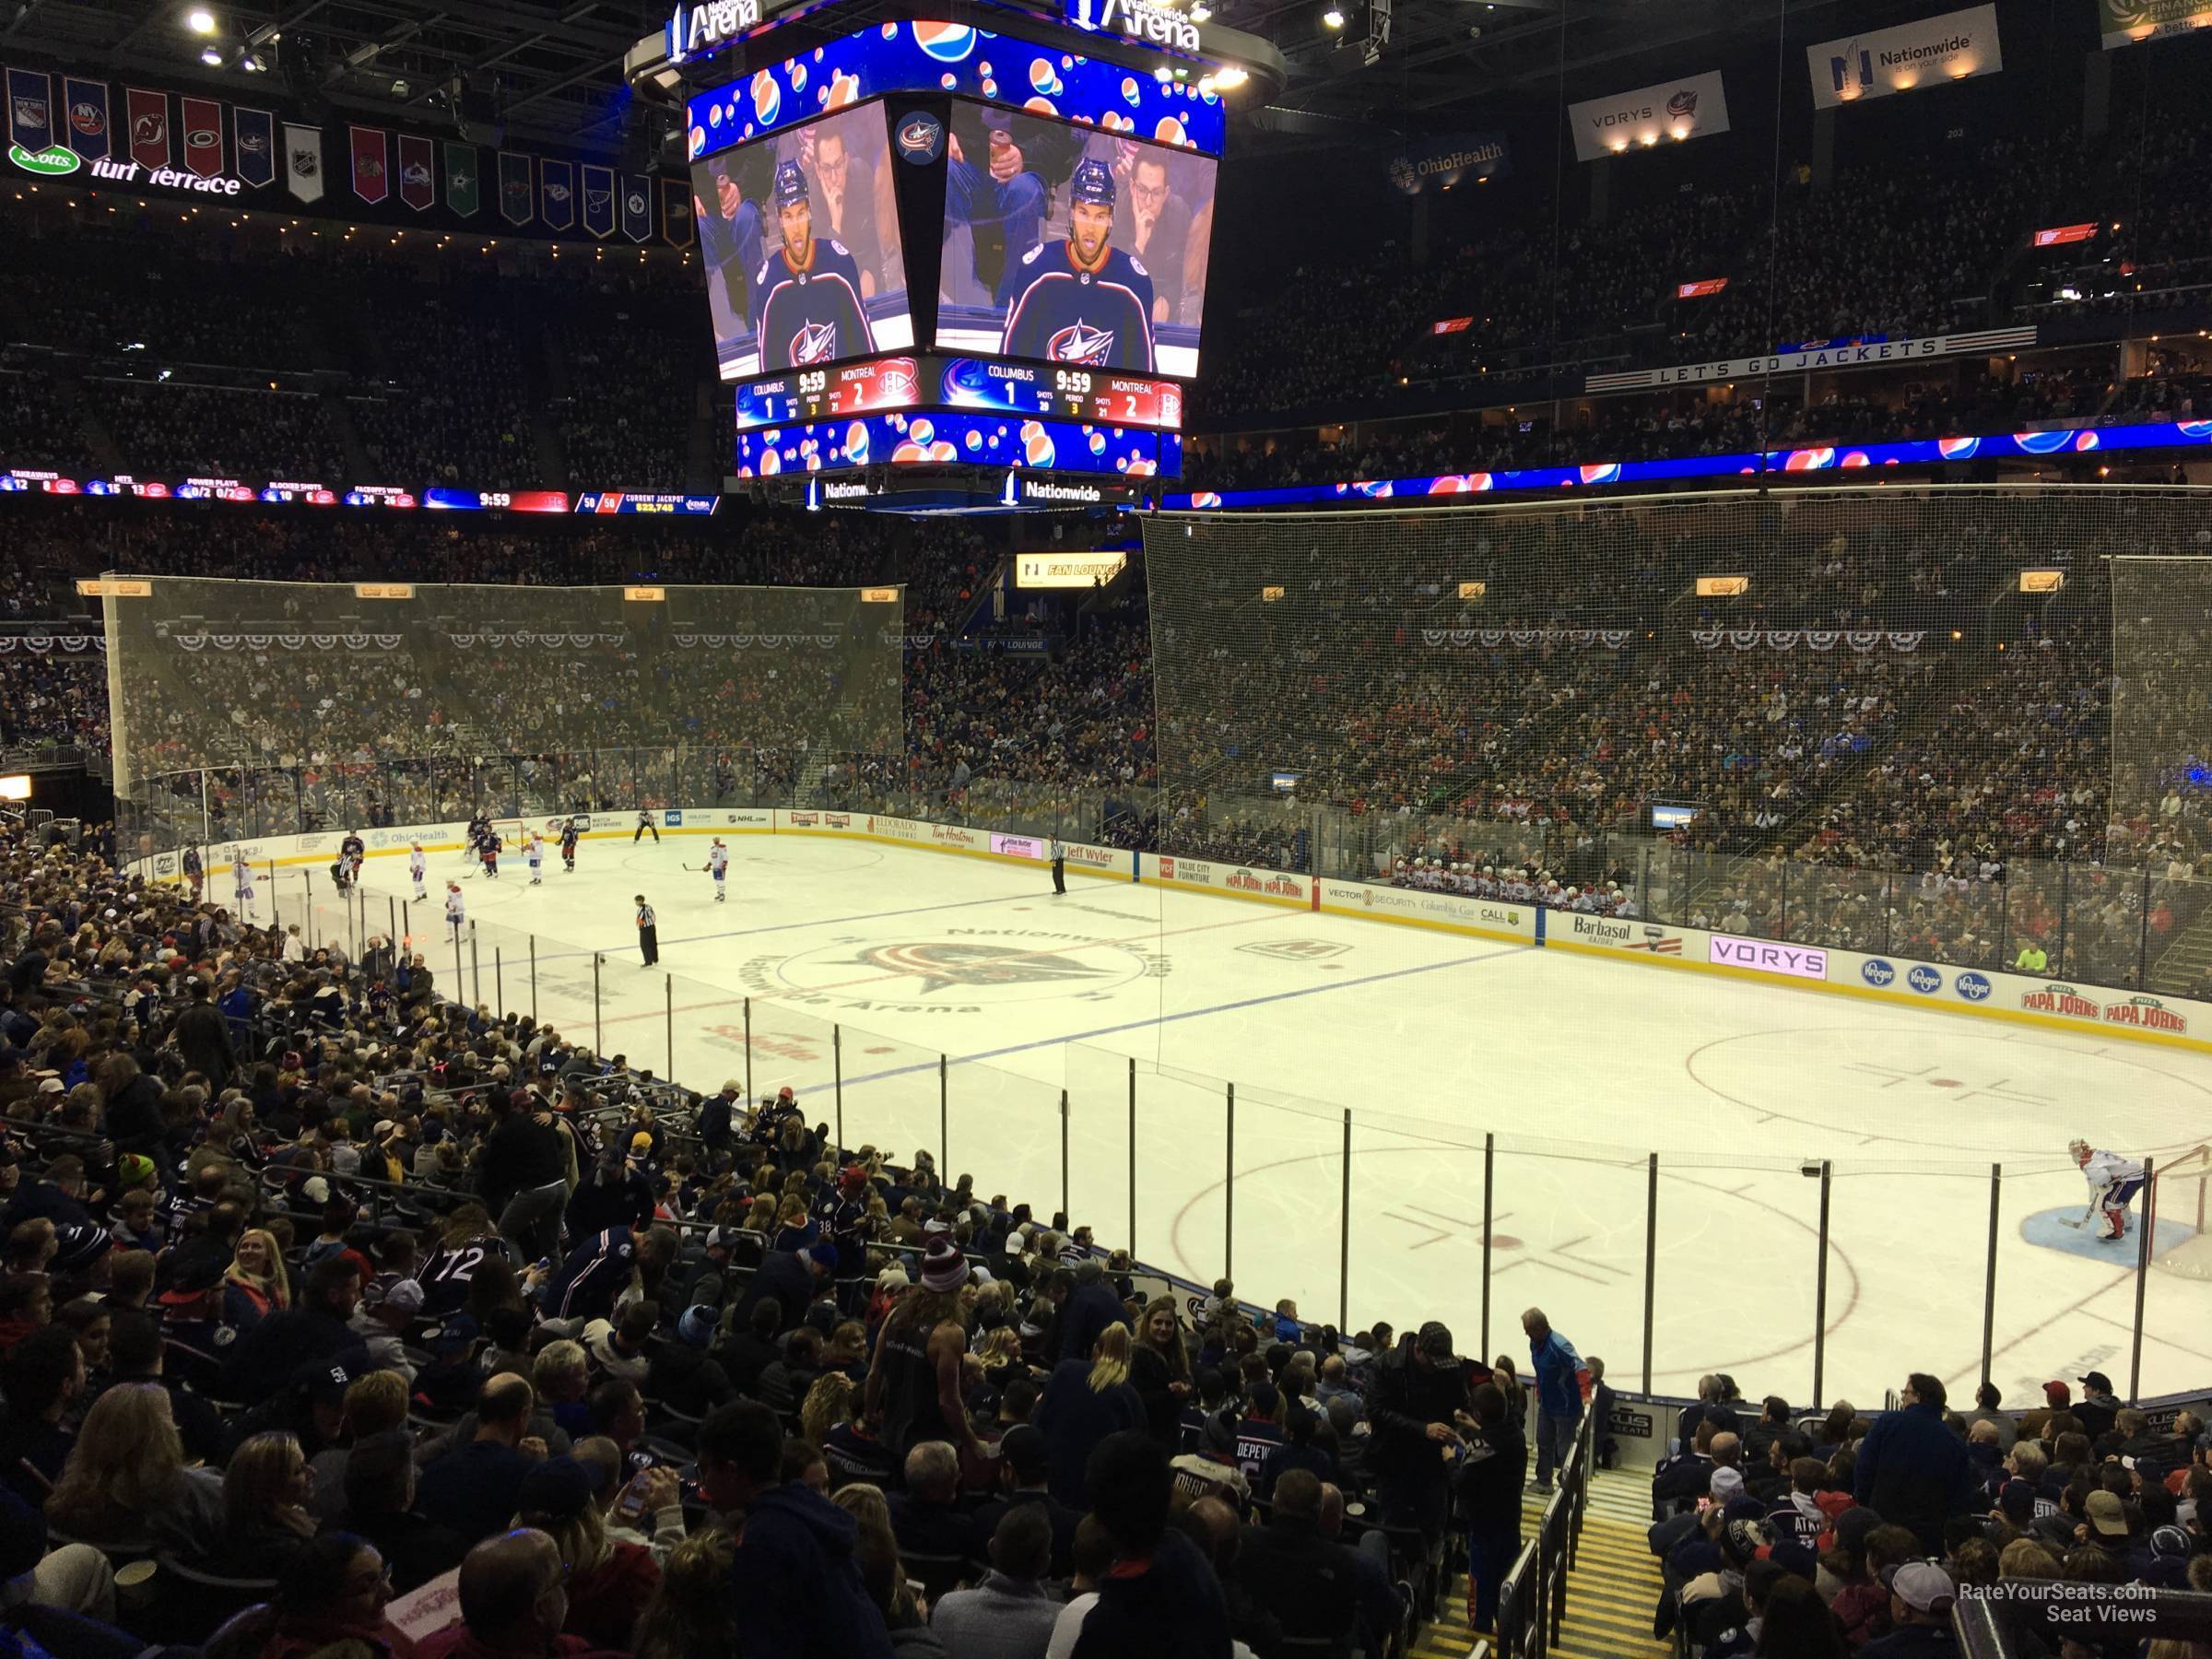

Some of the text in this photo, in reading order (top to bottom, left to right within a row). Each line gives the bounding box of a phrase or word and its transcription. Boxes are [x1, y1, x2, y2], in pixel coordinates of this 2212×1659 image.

[688, 0, 758, 49] Arena
[1100, 0, 1200, 51] Arena
[1879, 35, 1972, 66] Nationwide
[1904, 61, 1917, 71] on
[1918, 55, 1938, 69] your
[1941, 52, 1959, 64] side
[1593, 107, 1653, 128] VORYS
[18, 149, 72, 168] Scotts
[1418, 142, 1503, 175] OhioHealth
[1660, 339, 1936, 383] LET'S GO JACKETS
[753, 367, 877, 396] COLUMBUS 9:59 MONTREAL
[988, 365, 1153, 394] COLUMBUS 9:59 MONTREAL
[765, 382, 864, 418] 1 2
[1005, 382, 1136, 418] 1 2
[1036, 391, 1111, 406] SHOTS PERIOD SHOTS
[811, 404, 817, 415] 3
[1072, 403, 1078, 414] 3
[11, 470, 58, 479] TAKEAWAYS
[14, 479, 51, 491] 12 8
[107, 483, 145, 495] 15 13
[187, 477, 239, 488] POWER PLAYS
[269, 482, 323, 491] BLOCKED SHOTS
[191, 487, 235, 499] 0/2 0/2
[279, 490, 312, 501] 10 6
[626, 494, 684, 502] CURRENT JACKPOT
[1026, 481, 1100, 501] Nationwide
[363, 494, 396, 505] 24 26
[479, 493, 510, 507] 9:59
[583, 498, 615, 508] 50 50
[636, 503, 674, 512] $22,745
[1048, 564, 1072, 575] FAN
[1006, 641, 1043, 649] LOUNGE
[666, 814, 680, 822] IGS
[877, 818, 916, 830] ELDORADO
[931, 824, 974, 844] Tim Hortons
[1067, 845, 1083, 859] Jeff
[1084, 848, 1113, 864] Wyler
[1159, 862, 1173, 874] VCF
[1178, 861, 1210, 873] VALUE CITY
[1178, 871, 1210, 883] FURNITURE
[1226, 875, 1241, 887] PAPA
[1265, 880, 1281, 894] PAPA
[1328, 888, 1417, 908] VECTOR SECURITY
[1480, 909, 1505, 920] CALL
[1574, 916, 1631, 940] Barbasol
[1588, 935, 1614, 946] RAZORS
[1714, 940, 1823, 973] VORYS
[1864, 962, 1893, 985] Kroger
[1910, 969, 1940, 994] Kroger
[1958, 976, 1991, 1001] Kroger
[836, 1001, 982, 1013] Arena
[2024, 993, 2055, 1012] PAPA
[2136, 997, 2158, 1006] PIZZA
[2106, 1006, 2140, 1023] PAPA
[818, 1219, 831, 1233] 38
[435, 1247, 484, 1282] 72
[1237, 1441, 1271, 1461] DEPEW
